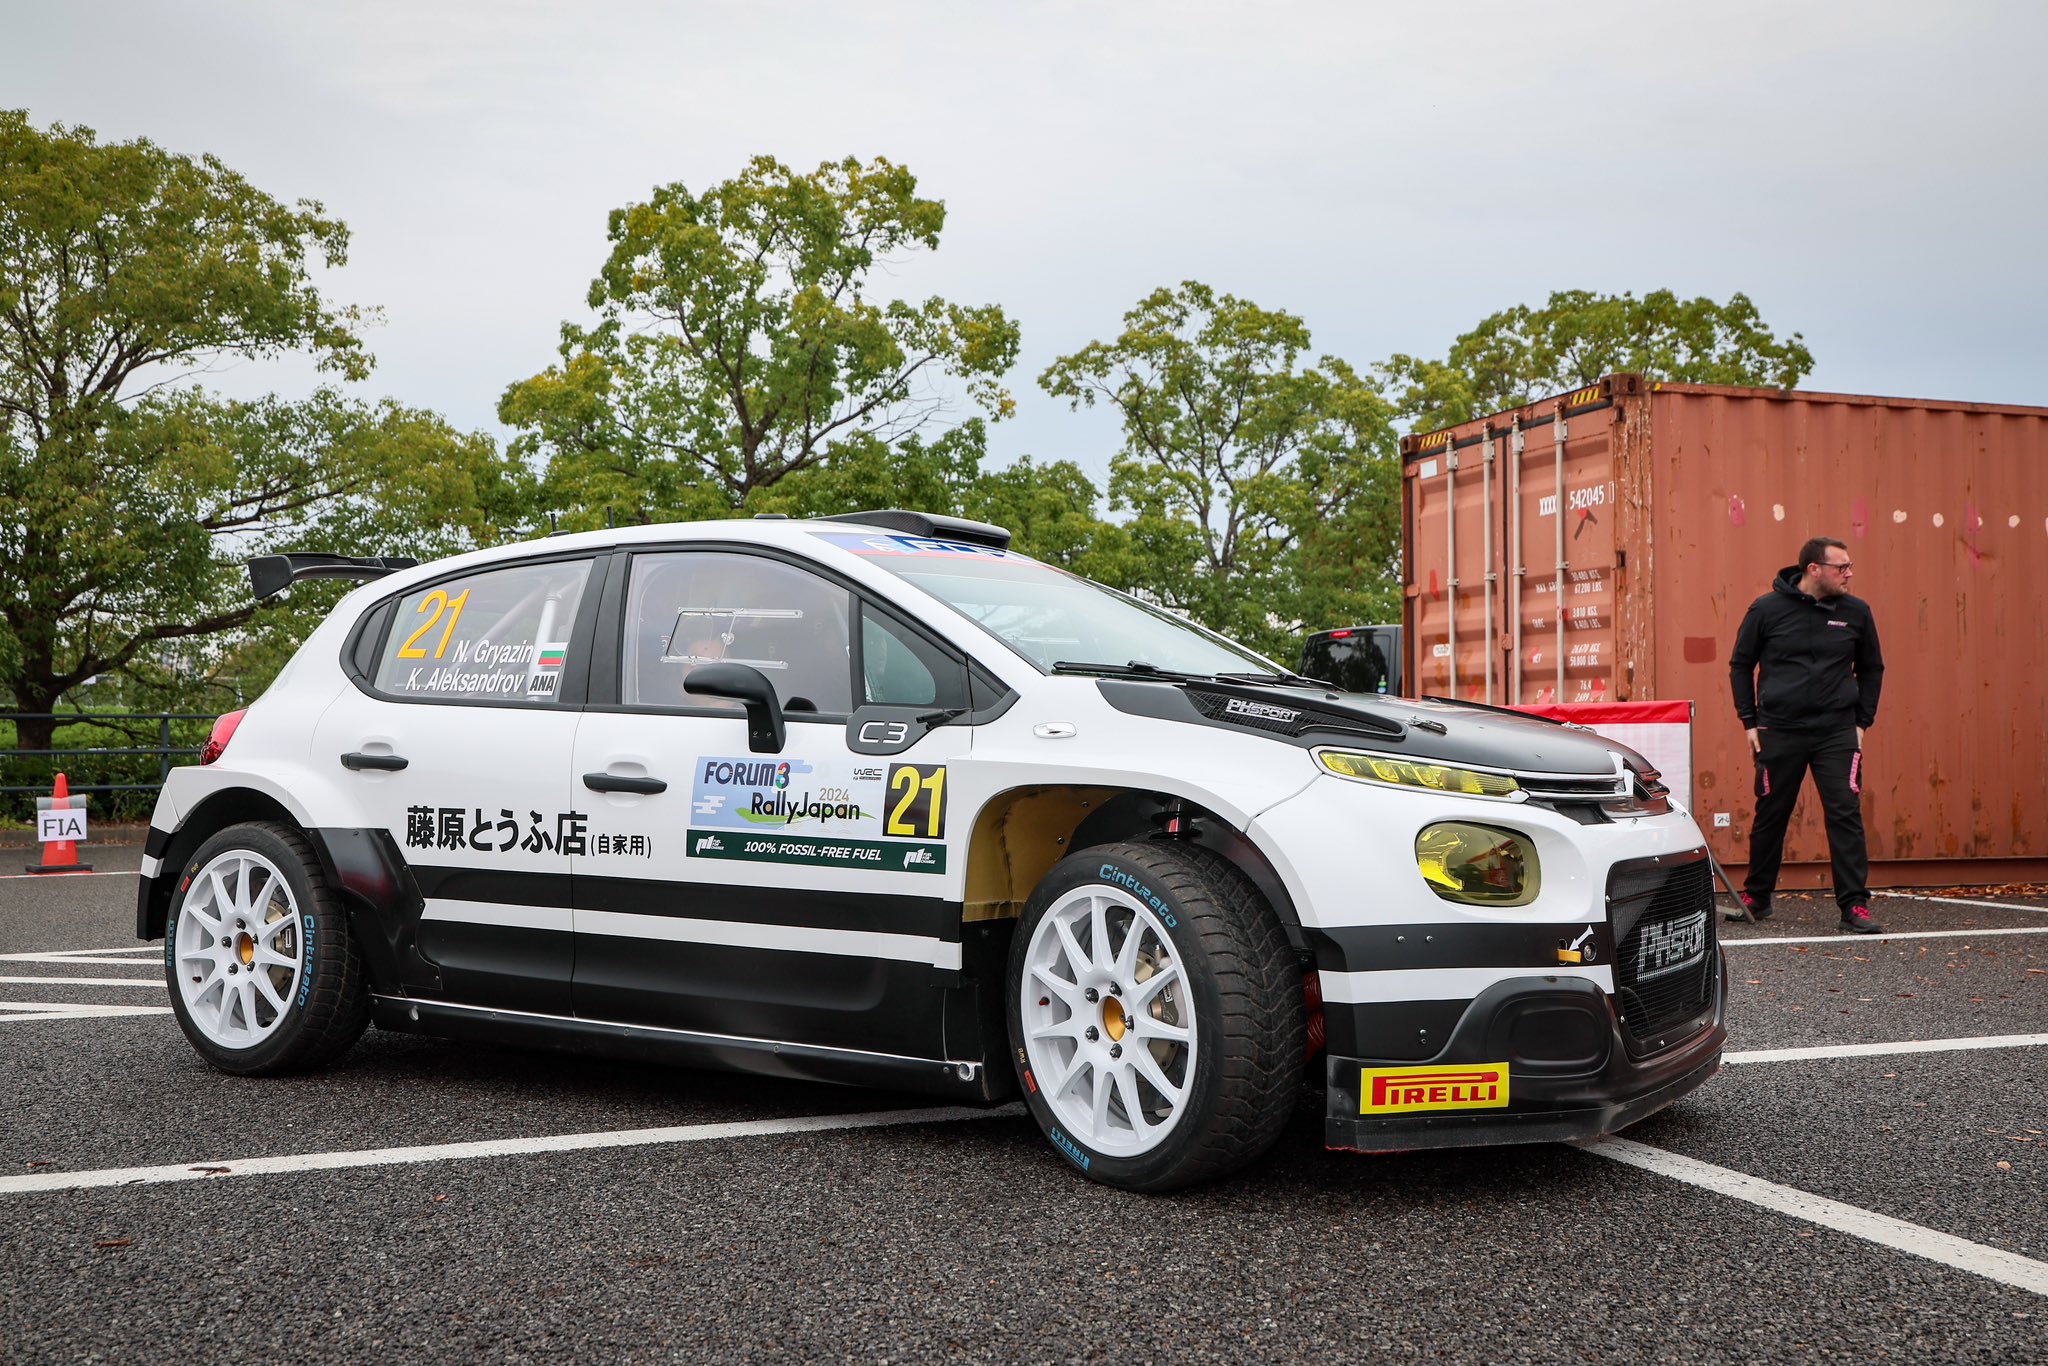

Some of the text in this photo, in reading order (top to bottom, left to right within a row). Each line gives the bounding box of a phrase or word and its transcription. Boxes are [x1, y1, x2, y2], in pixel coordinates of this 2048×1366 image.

[1569, 485, 1605, 510] 542045
[397, 588, 471, 660] 21
[452, 639, 534, 670] N. Gryazin
[405, 667, 526, 693] K. Aleksandrov
[529, 675, 556, 692] ANA
[858, 720, 909, 744] C3
[704, 761, 791, 789] FORUM8
[853, 768, 883, 776] WRC
[819, 787, 850, 802] 2024
[887, 766, 946, 837] 21
[43, 817, 83, 837] FIA
[744, 841, 882, 861] 100% FOSSIL-FREE FUEL
[1371, 1071, 1499, 1106] PIRELLI
[1050, 1126, 1090, 1171] PIRELLI
